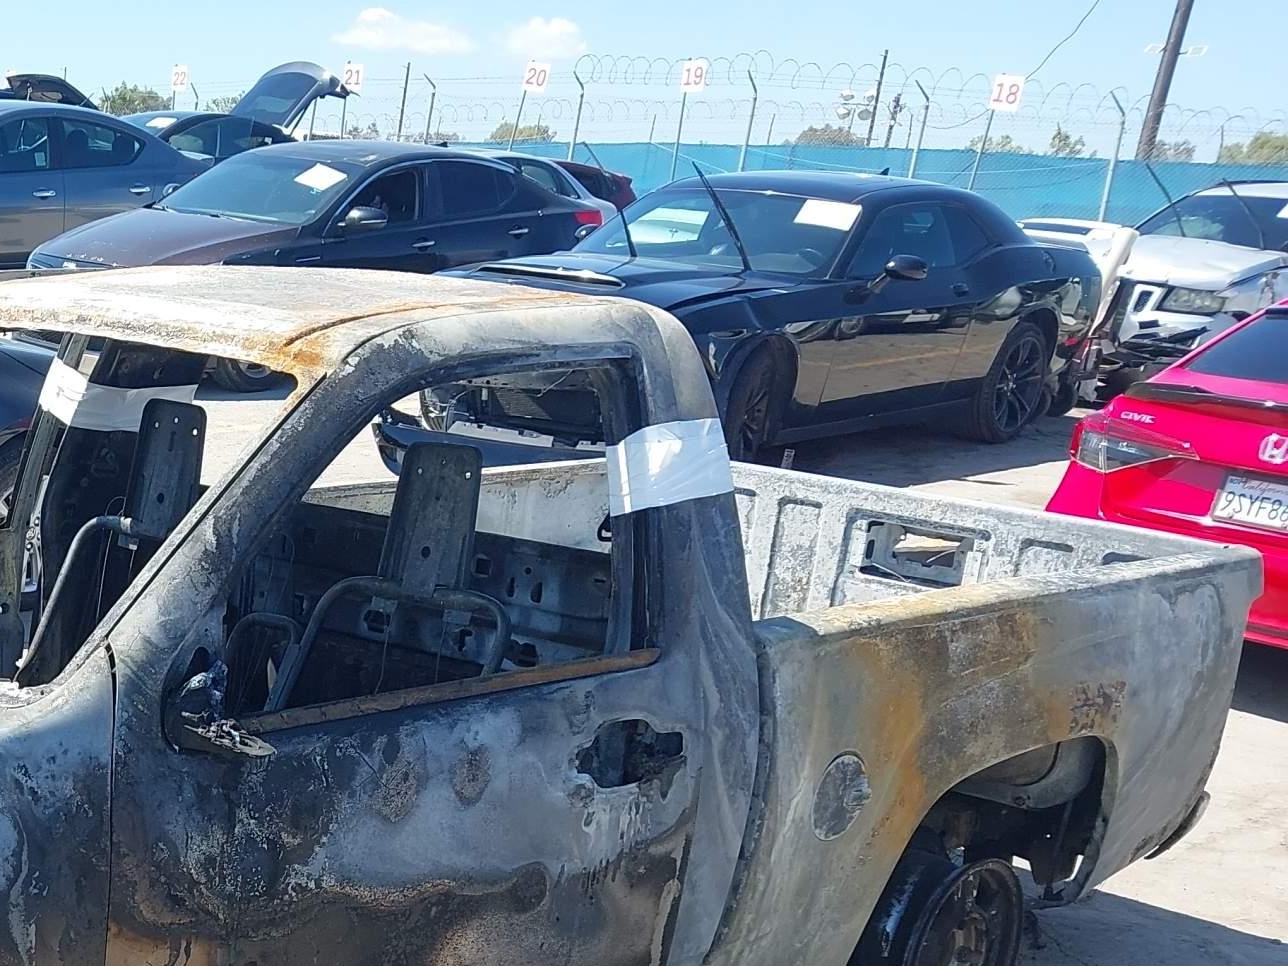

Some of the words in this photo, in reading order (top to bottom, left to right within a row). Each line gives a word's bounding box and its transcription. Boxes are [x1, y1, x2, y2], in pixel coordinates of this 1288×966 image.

[173, 71, 186, 86] 22
[344, 69, 361, 86] 21
[525, 67, 547, 87] 20
[683, 66, 704, 86] 19
[992, 83, 1020, 105] 18
[1120, 411, 1157, 424] CIVIC
